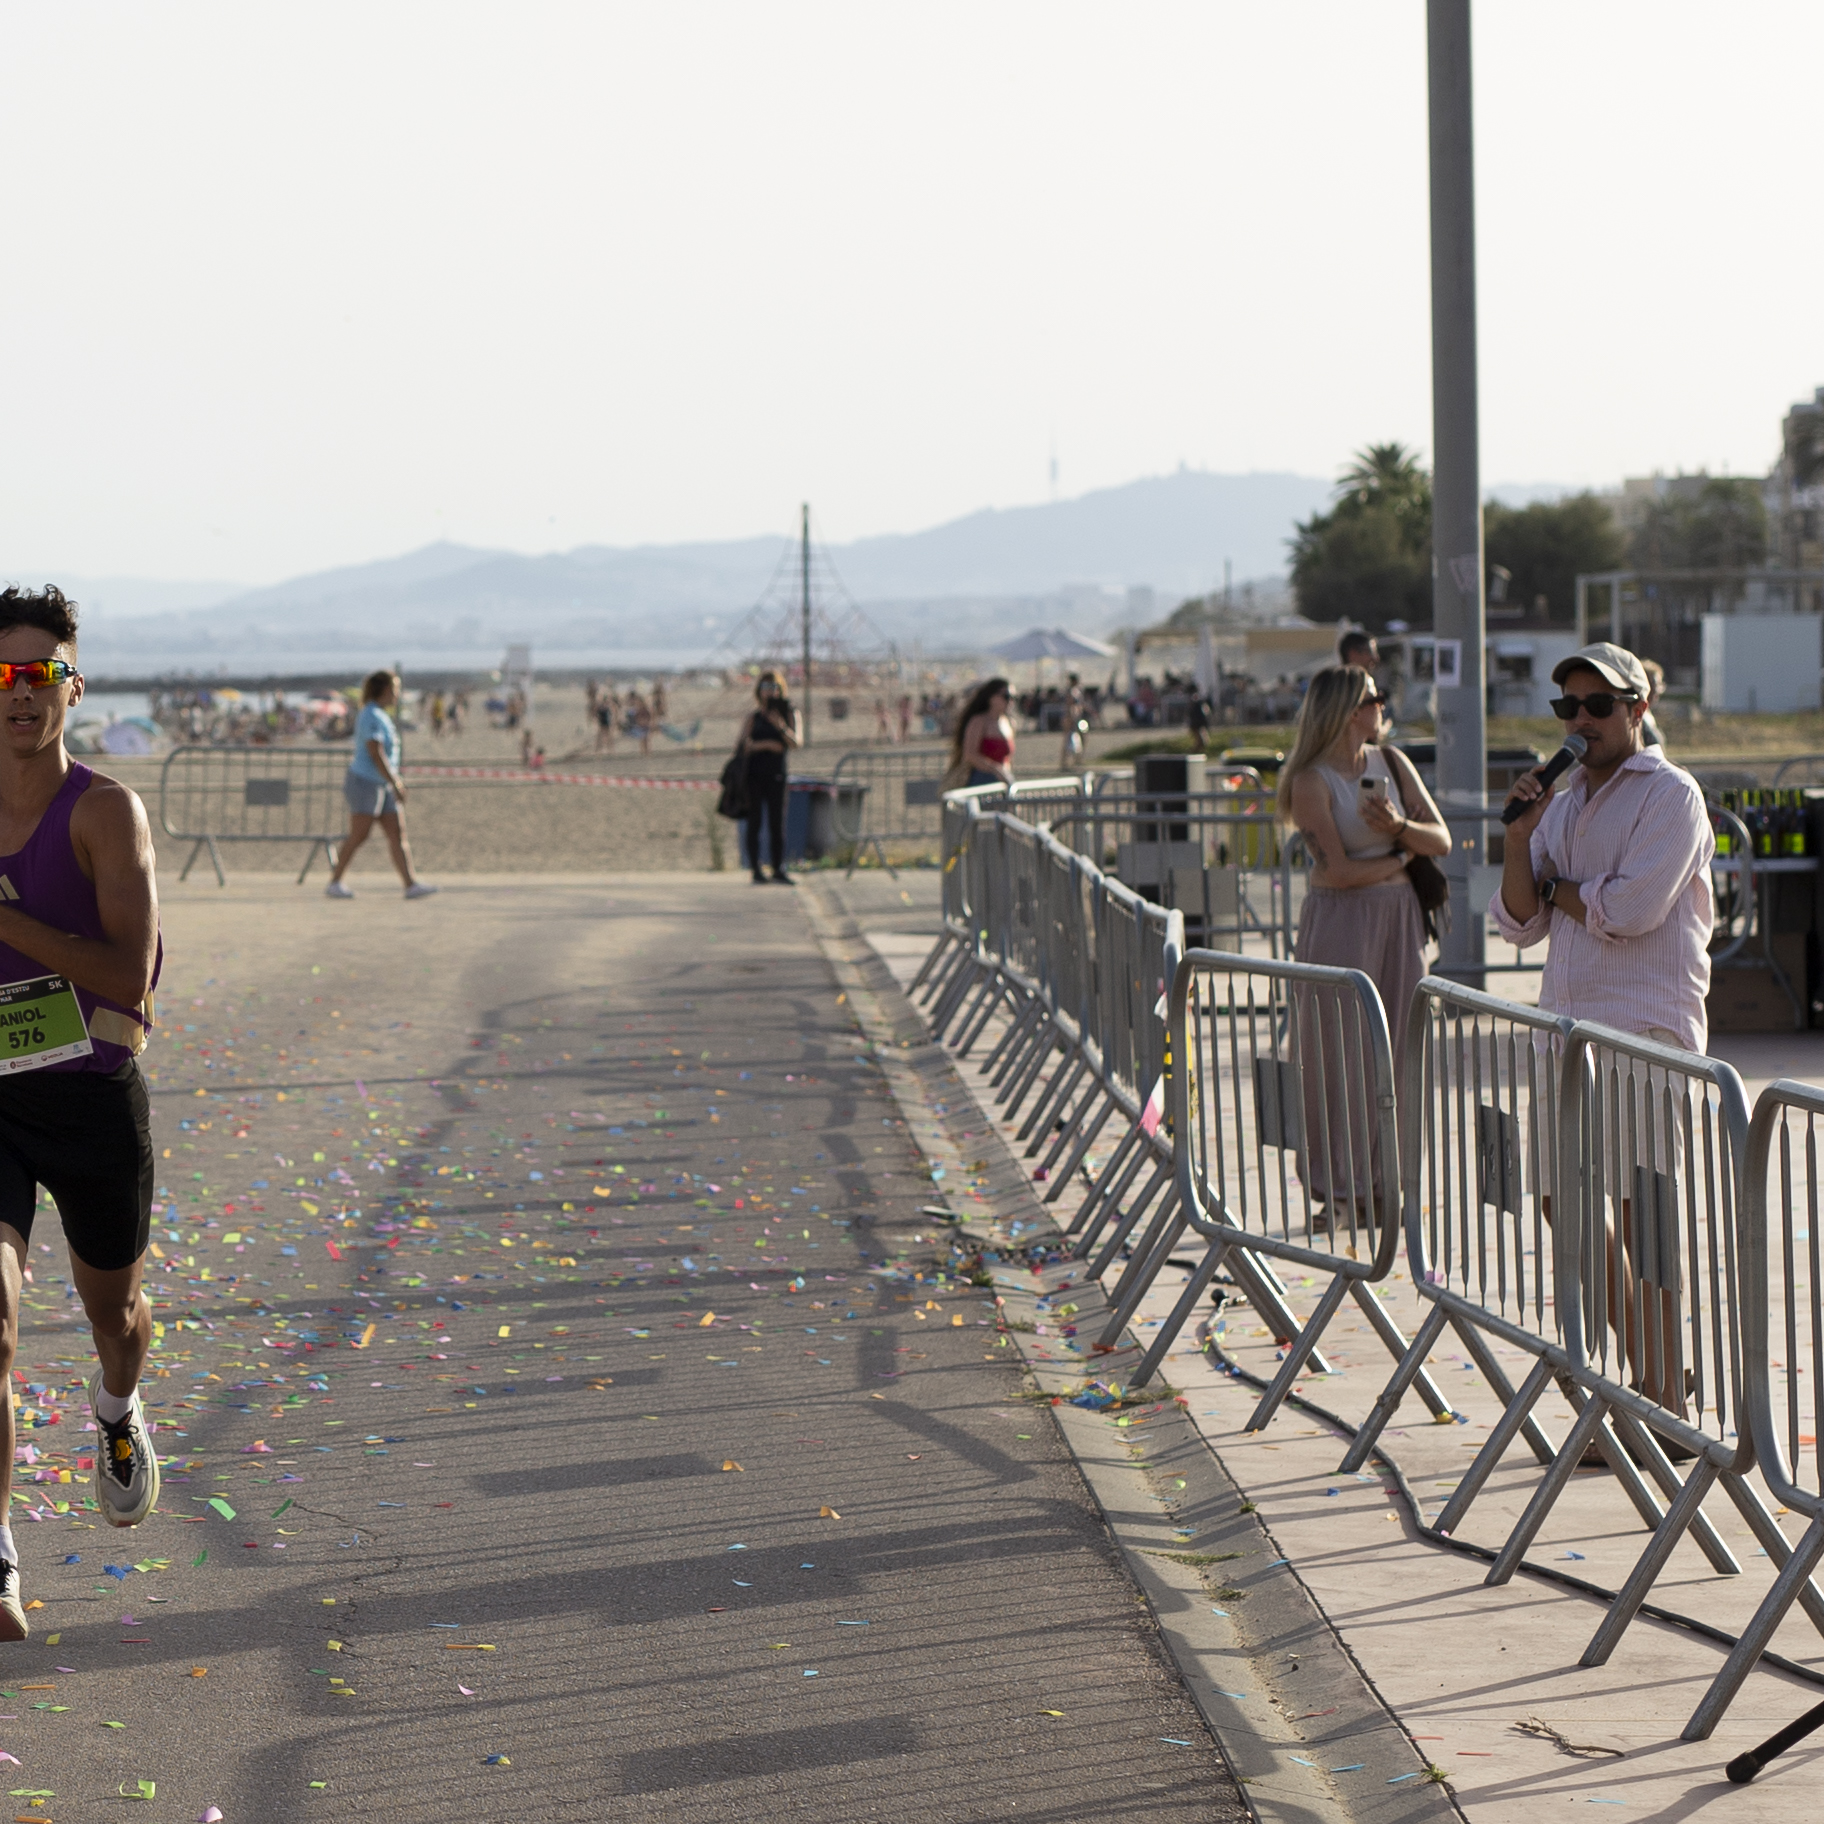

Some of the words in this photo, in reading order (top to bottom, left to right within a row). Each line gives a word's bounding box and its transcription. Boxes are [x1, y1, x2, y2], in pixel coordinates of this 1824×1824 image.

[48, 979, 64, 990] 5K
[0, 1007, 47, 1028] ANIOL
[8, 1026, 46, 1049] 576
